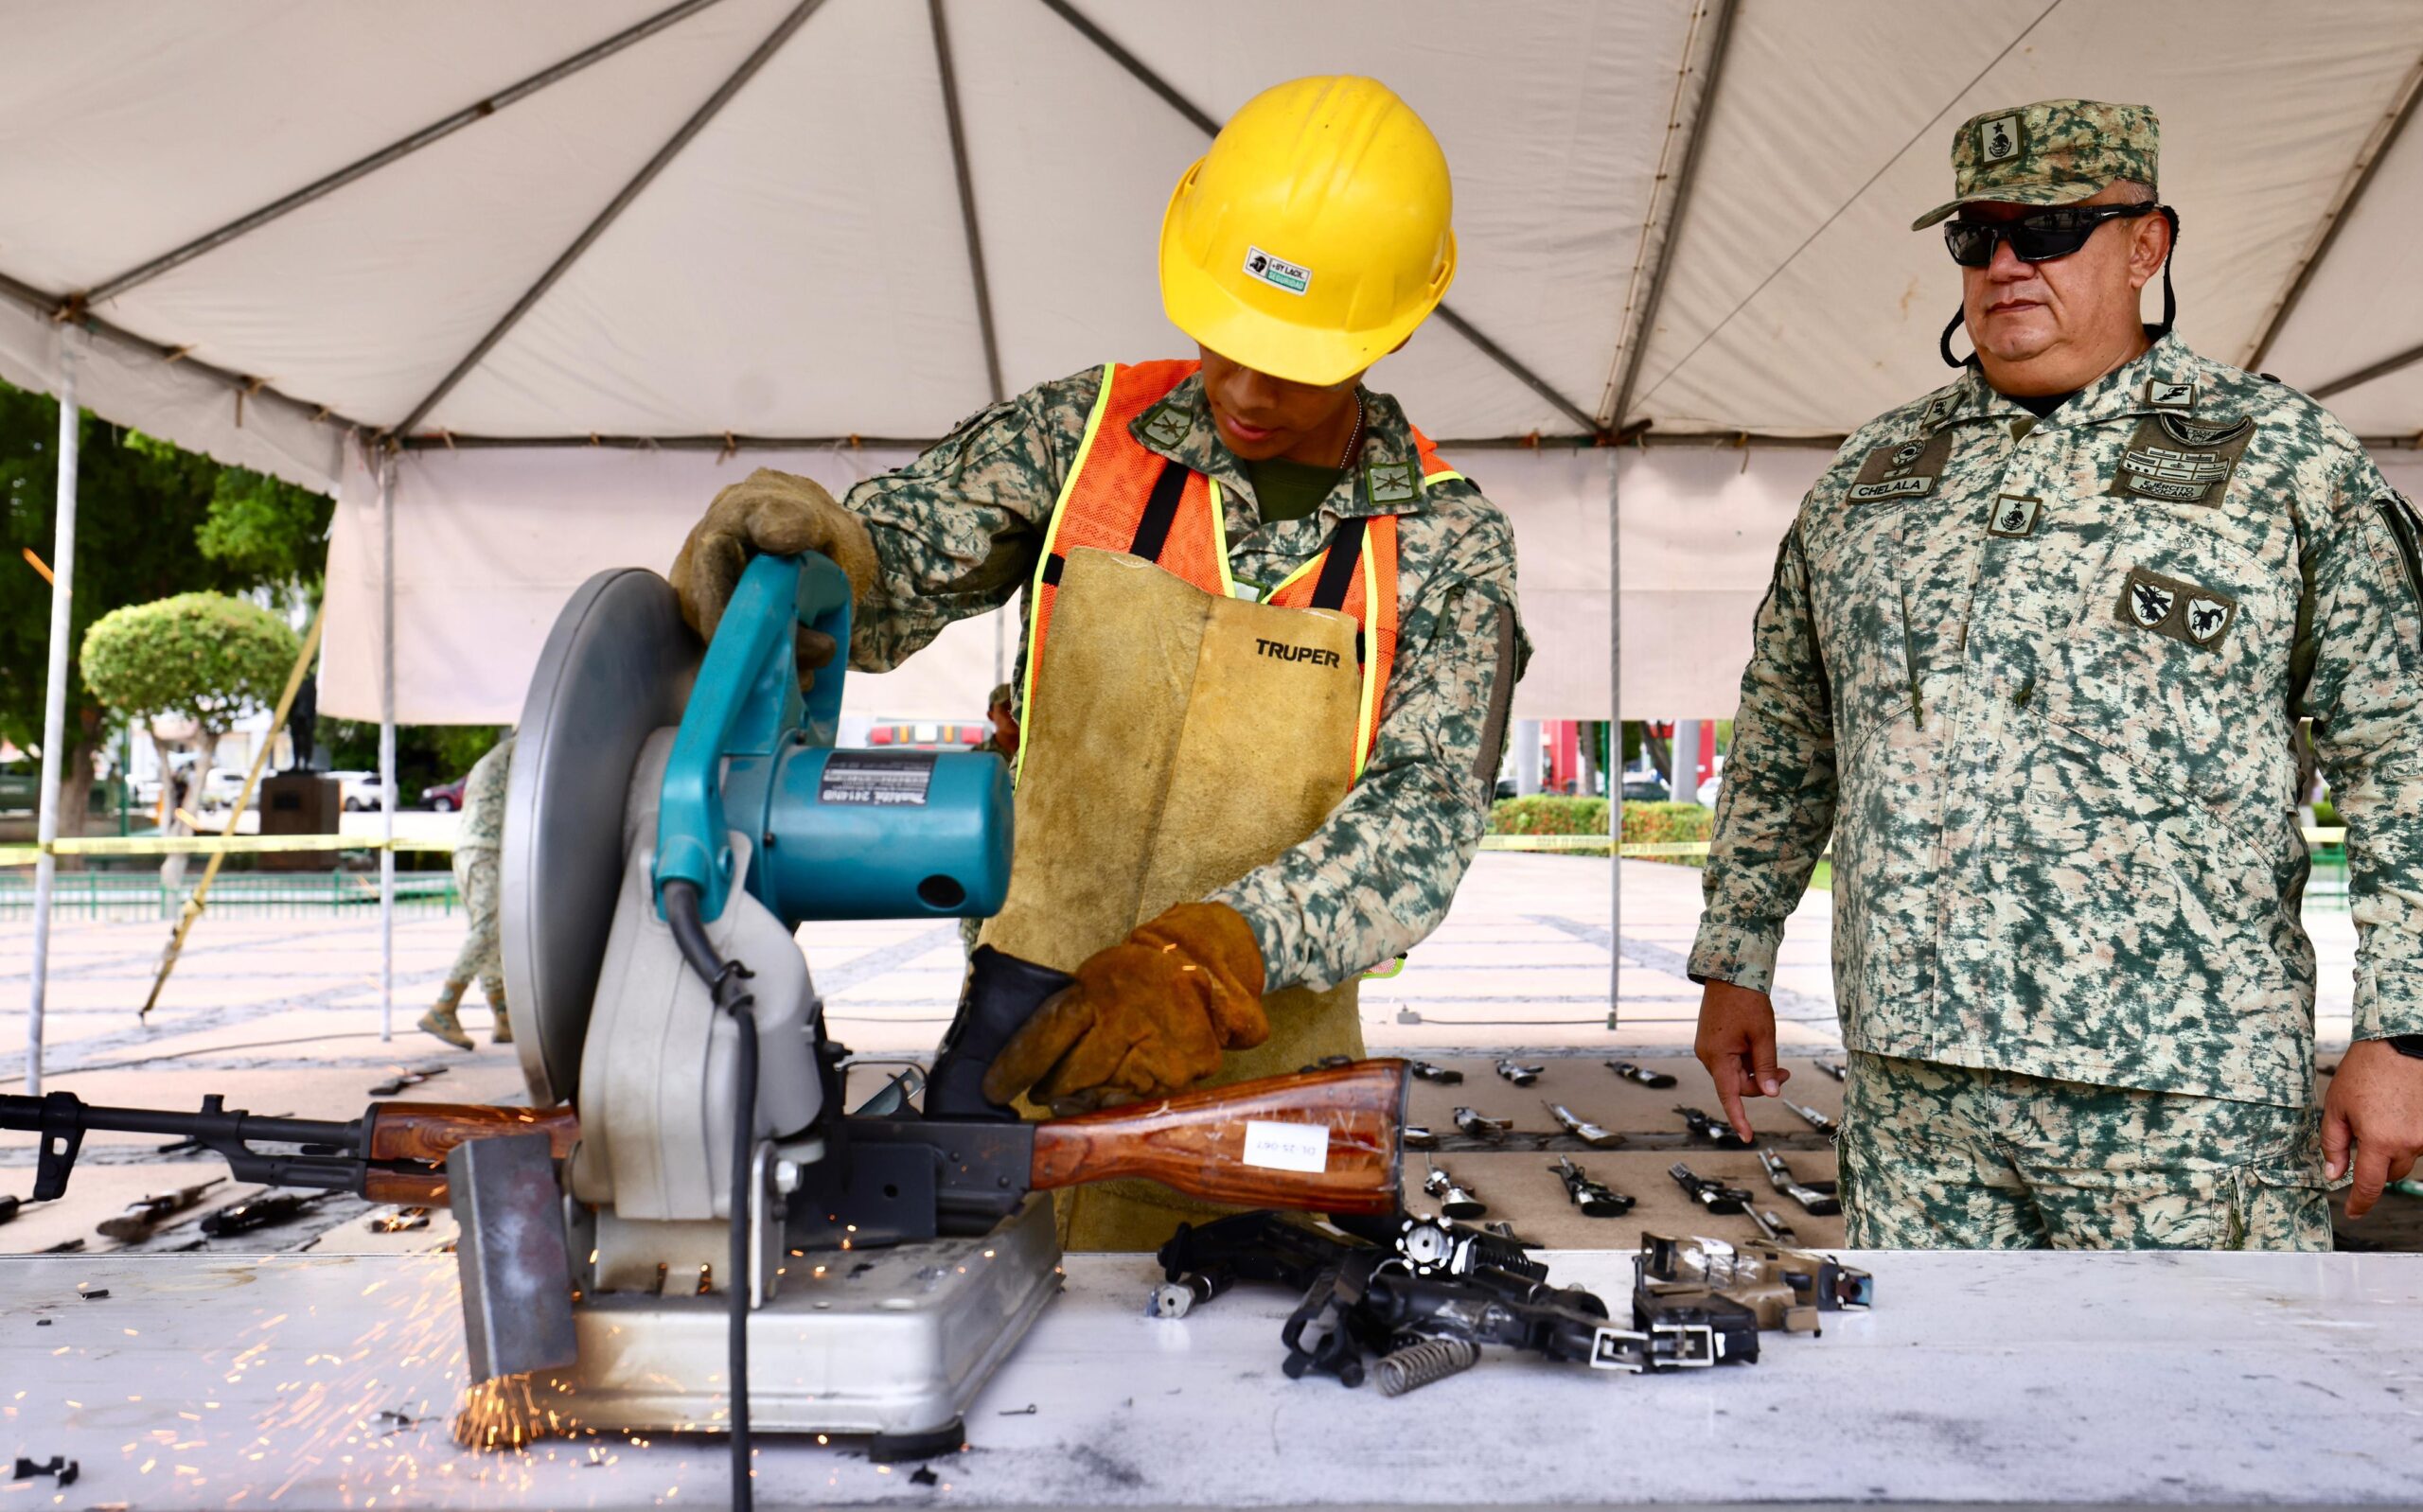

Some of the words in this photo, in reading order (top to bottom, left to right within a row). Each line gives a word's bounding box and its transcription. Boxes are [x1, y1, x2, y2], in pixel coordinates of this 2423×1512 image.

[1858, 480, 1920, 497] CHELALA
[2139, 484, 2194, 498] MEXICANO
[2143, 480, 2194, 492] EJÉRCITO
[1256, 638, 1340, 669] TRUPER
